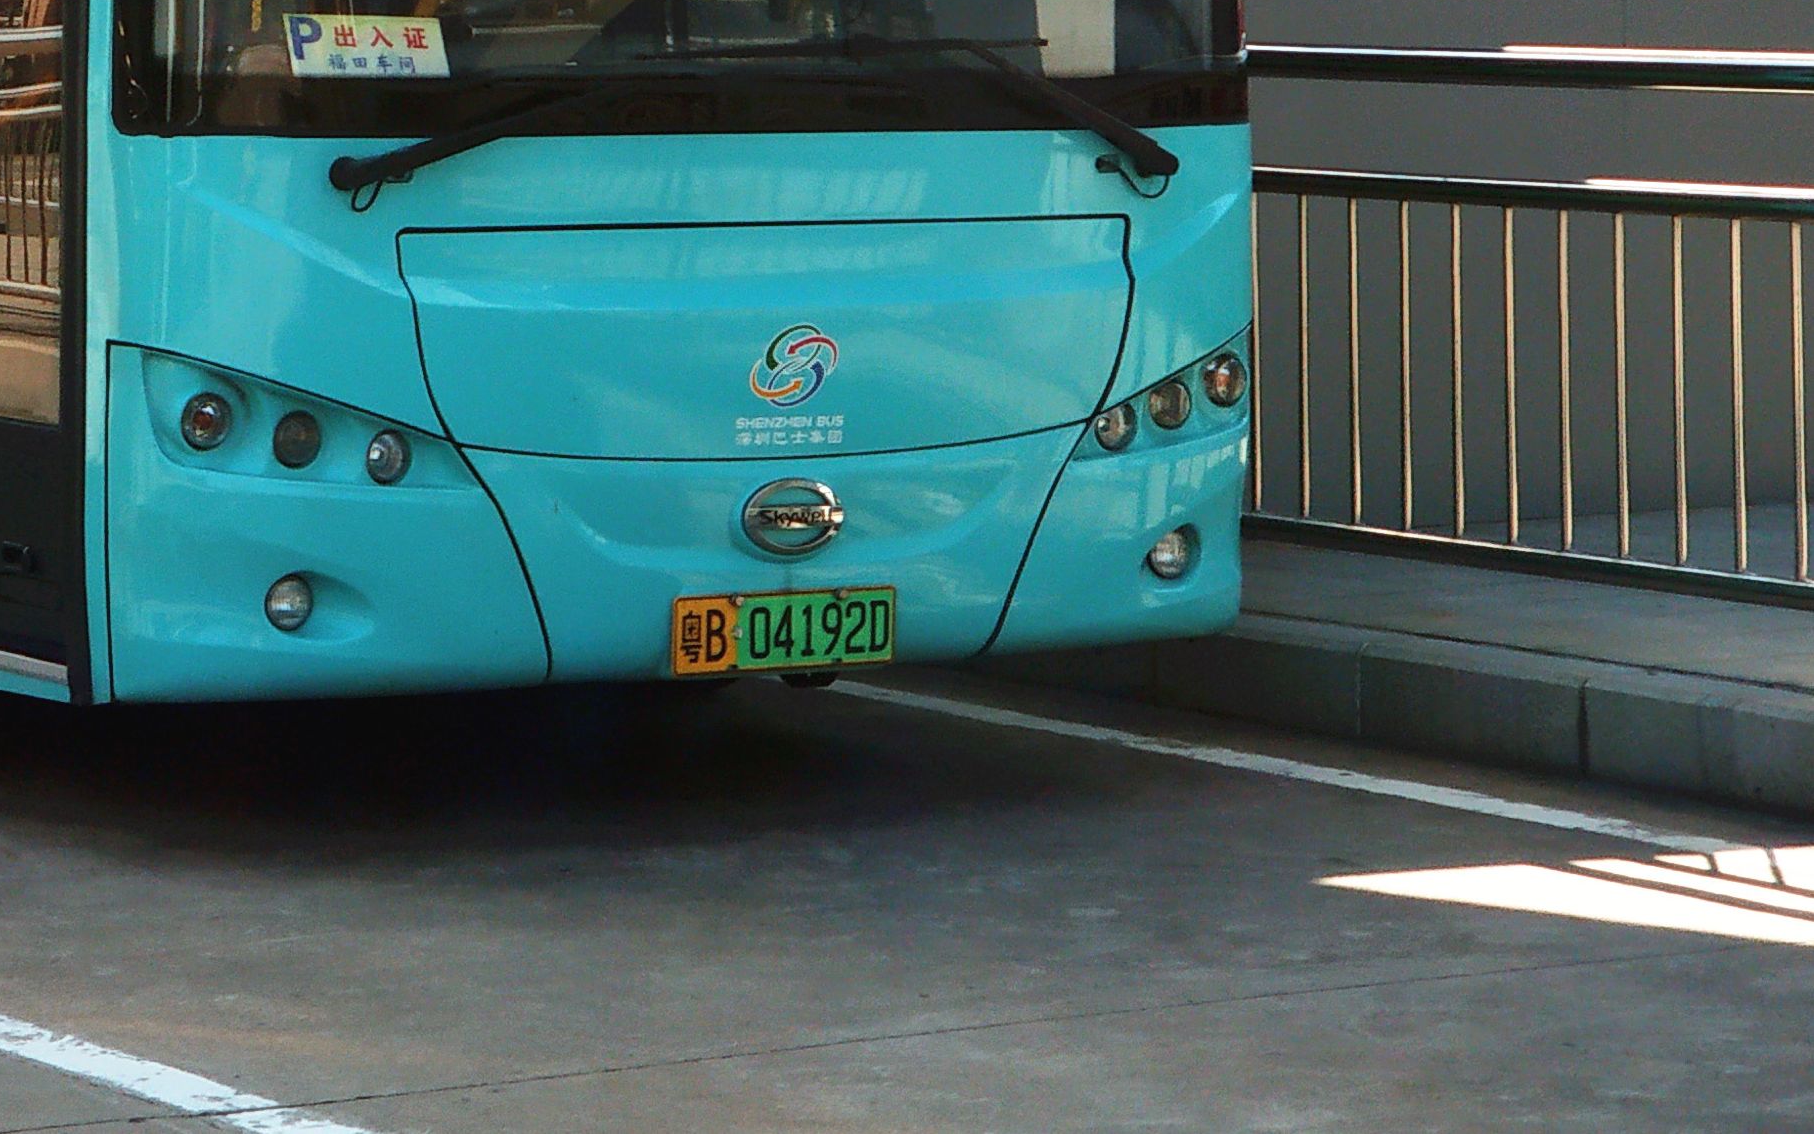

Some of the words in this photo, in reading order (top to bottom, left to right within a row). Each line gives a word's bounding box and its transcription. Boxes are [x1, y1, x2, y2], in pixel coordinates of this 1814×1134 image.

[333, 24, 429, 50] 出入证
[735, 416, 813, 429] SHENZHEN
[816, 414, 844, 427] BUS
[748, 599, 891, 660] 04192D
